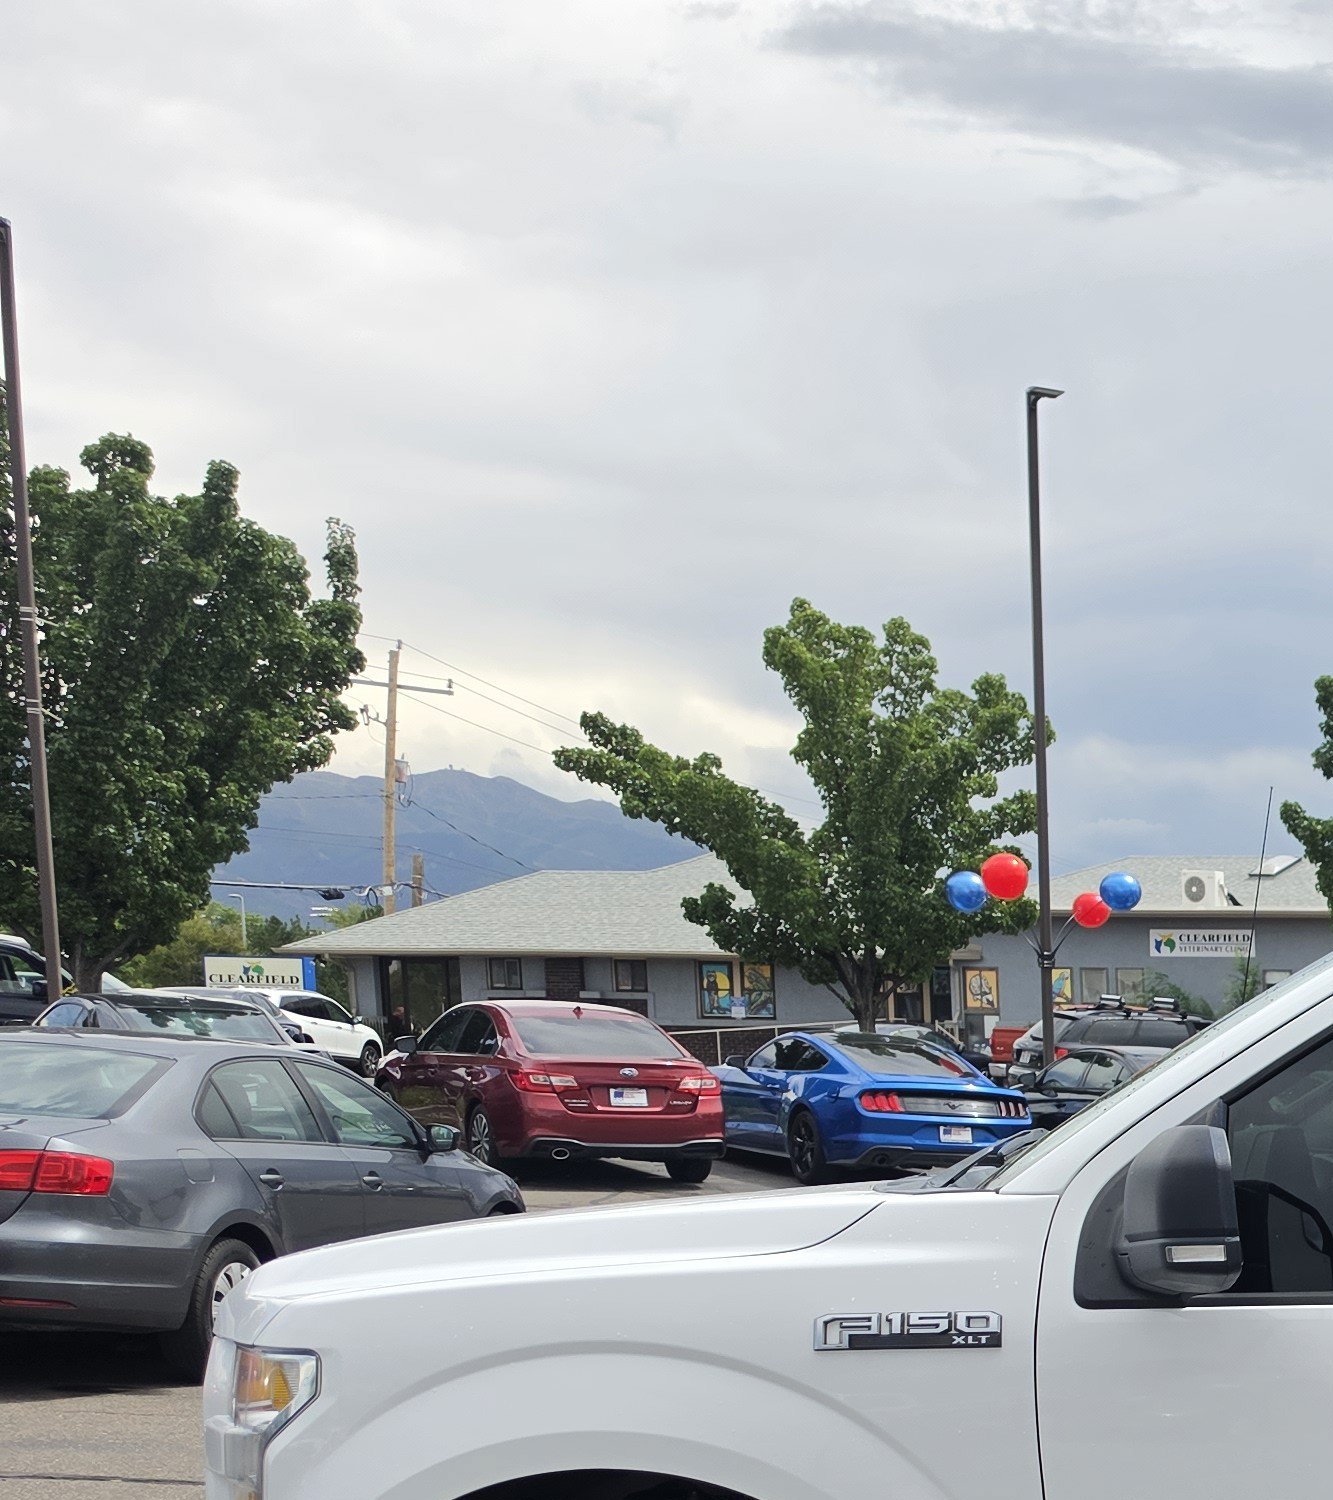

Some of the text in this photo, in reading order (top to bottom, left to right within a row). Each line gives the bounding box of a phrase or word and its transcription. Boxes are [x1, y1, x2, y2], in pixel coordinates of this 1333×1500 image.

[1179, 934, 1251, 942] CLEARFIELD
[1179, 945, 1223, 953] VETERINARY
[209, 974, 300, 985] CLEARFIELD
[952, 1335, 991, 1344] XLT
